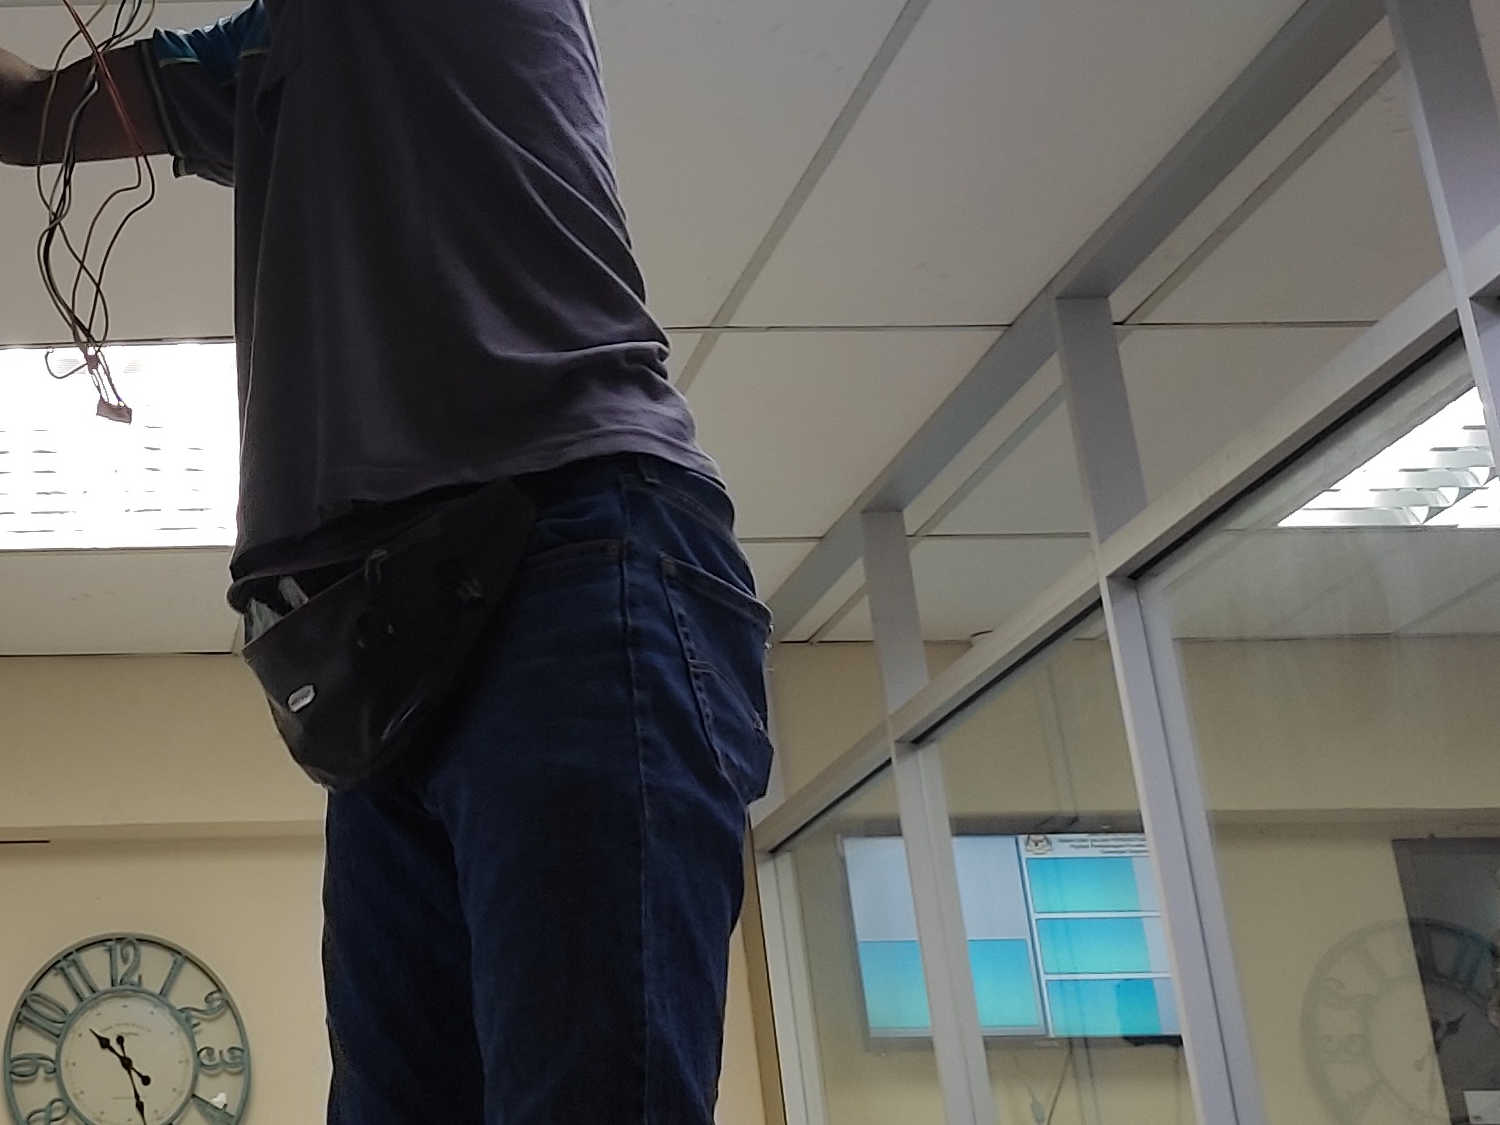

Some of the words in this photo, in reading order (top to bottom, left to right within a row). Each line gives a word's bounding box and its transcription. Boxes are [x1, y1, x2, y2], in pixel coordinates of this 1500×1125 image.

[54, 952, 99, 1002] 11
[103, 938, 142, 988] 12
[160, 952, 186, 997] 1
[17, 992, 71, 1039] 10
[177, 989, 227, 1032] 2
[10, 1053, 58, 1078] 9
[197, 1045, 246, 1070] 3
